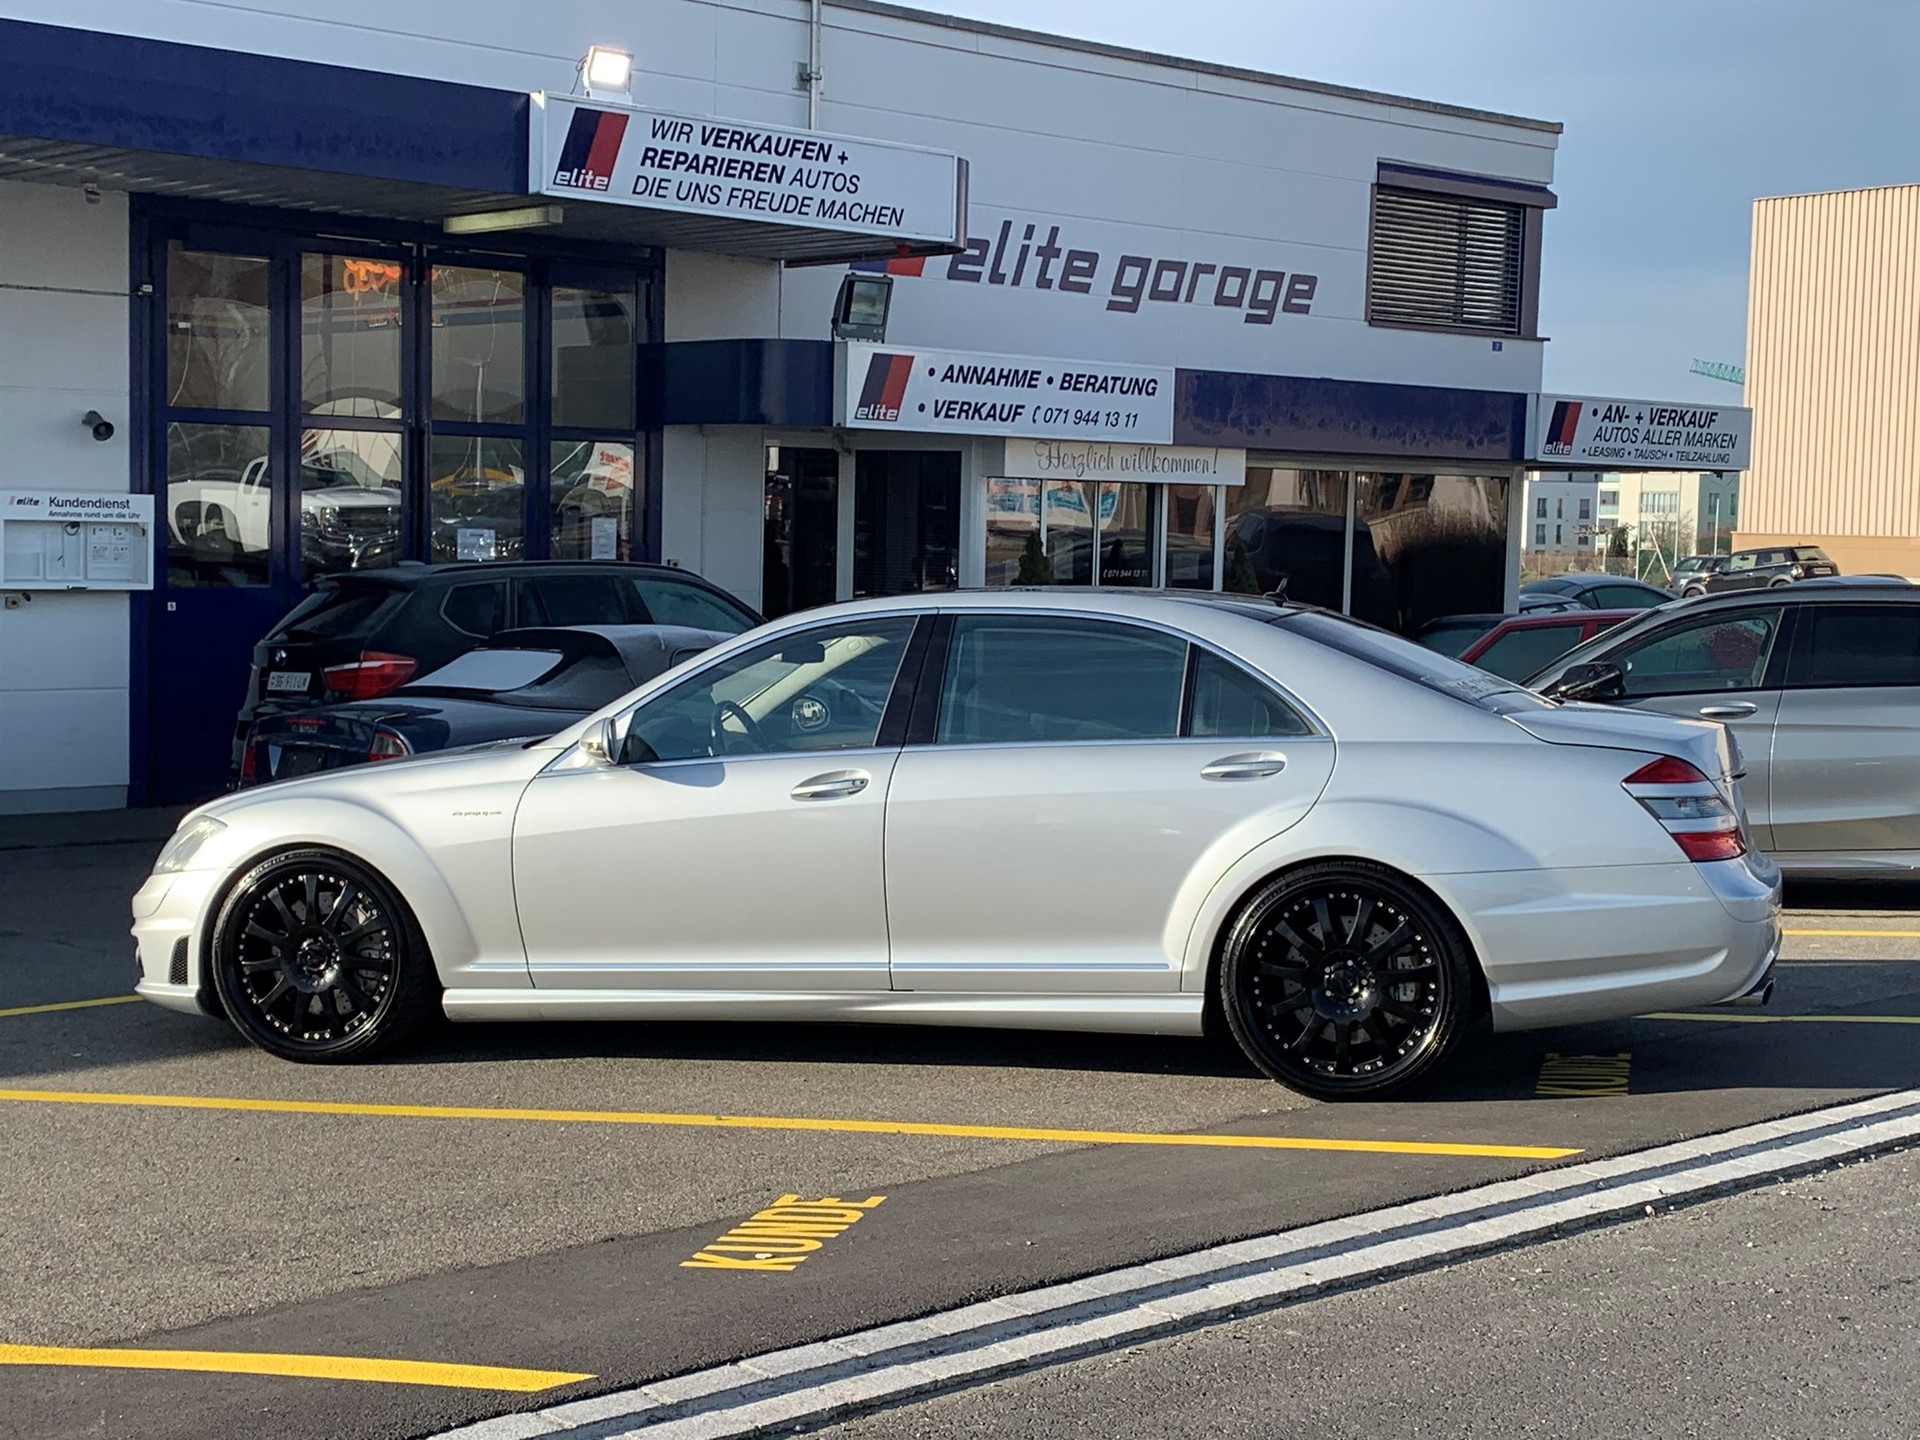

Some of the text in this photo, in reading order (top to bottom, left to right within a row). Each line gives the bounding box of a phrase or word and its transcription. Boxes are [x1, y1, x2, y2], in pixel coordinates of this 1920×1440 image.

[650, 117, 849, 165] WIR VERKAUFEN +
[554, 169, 609, 191] elite
[640, 146, 861, 194] REPARIEREN AUTOS
[631, 175, 905, 227] DIE UNS FREUDE MACHEN
[946, 219, 1318, 325] elite garage
[939, 363, 1159, 397] ANNAHME BERATUNG
[854, 406, 899, 421] elite
[932, 398, 1139, 429] VERKAUF 071 944 13 11
[1600, 405, 1719, 429] AN- + VERKAUF
[1543, 441, 1572, 455] elite
[1592, 425, 1738, 450] AUTOS ALLER MARKEN
[1034, 440, 1220, 478] Herzlich willkommen!
[1587, 446, 1731, 464] LEASING TAUSCH TEILZAHLUNG
[48, 496, 131, 509] Kundendienst
[48, 510, 82, 518] Annahme
[115, 511, 127, 519] die
[678, 1193, 888, 1272] KUNDE
